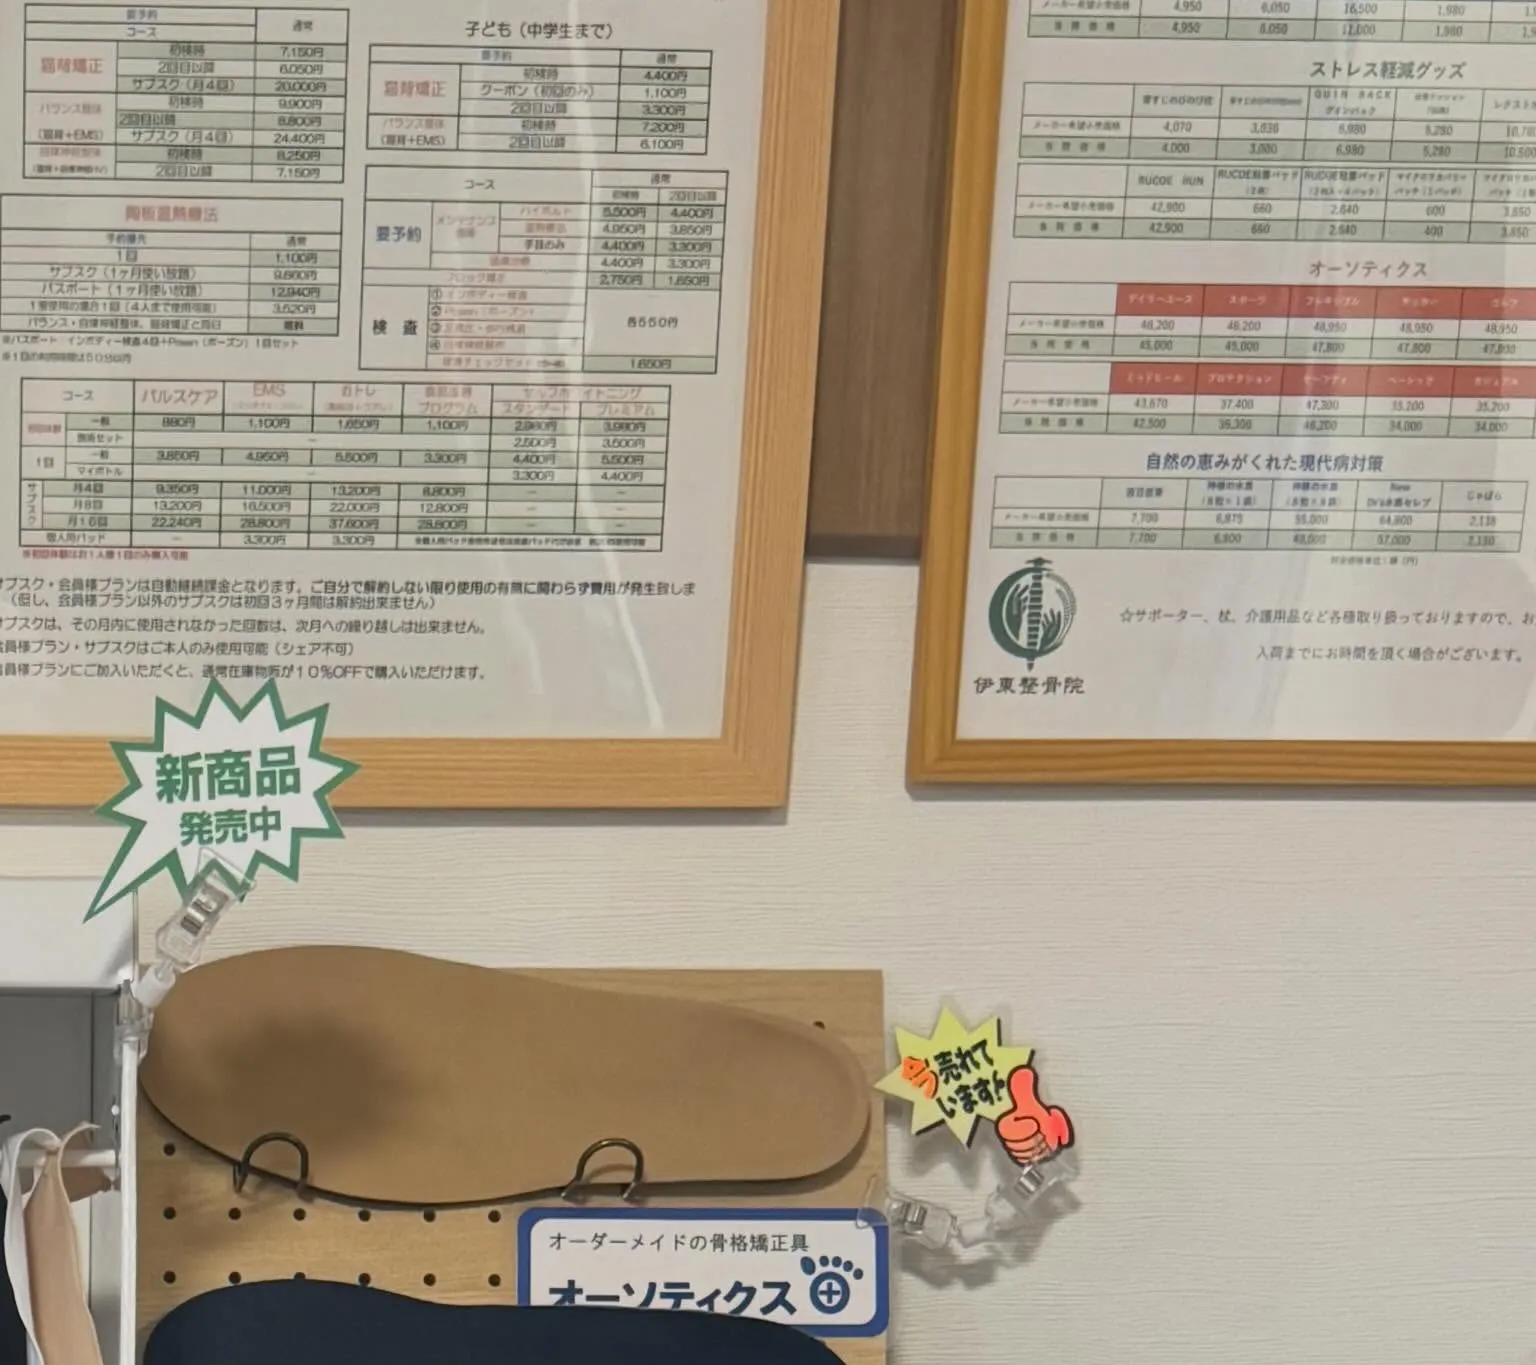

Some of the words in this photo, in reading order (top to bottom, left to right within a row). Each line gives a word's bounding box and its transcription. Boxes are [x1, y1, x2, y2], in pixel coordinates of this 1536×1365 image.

[1309, 260, 1428, 279] オーソティクス
[973, 675, 1086, 696] 伊東整骨院
[155, 746, 302, 804] 新商品
[178, 807, 284, 847] 発売中
[549, 1232, 810, 1253] オーダーメイドの骨格矯正具
